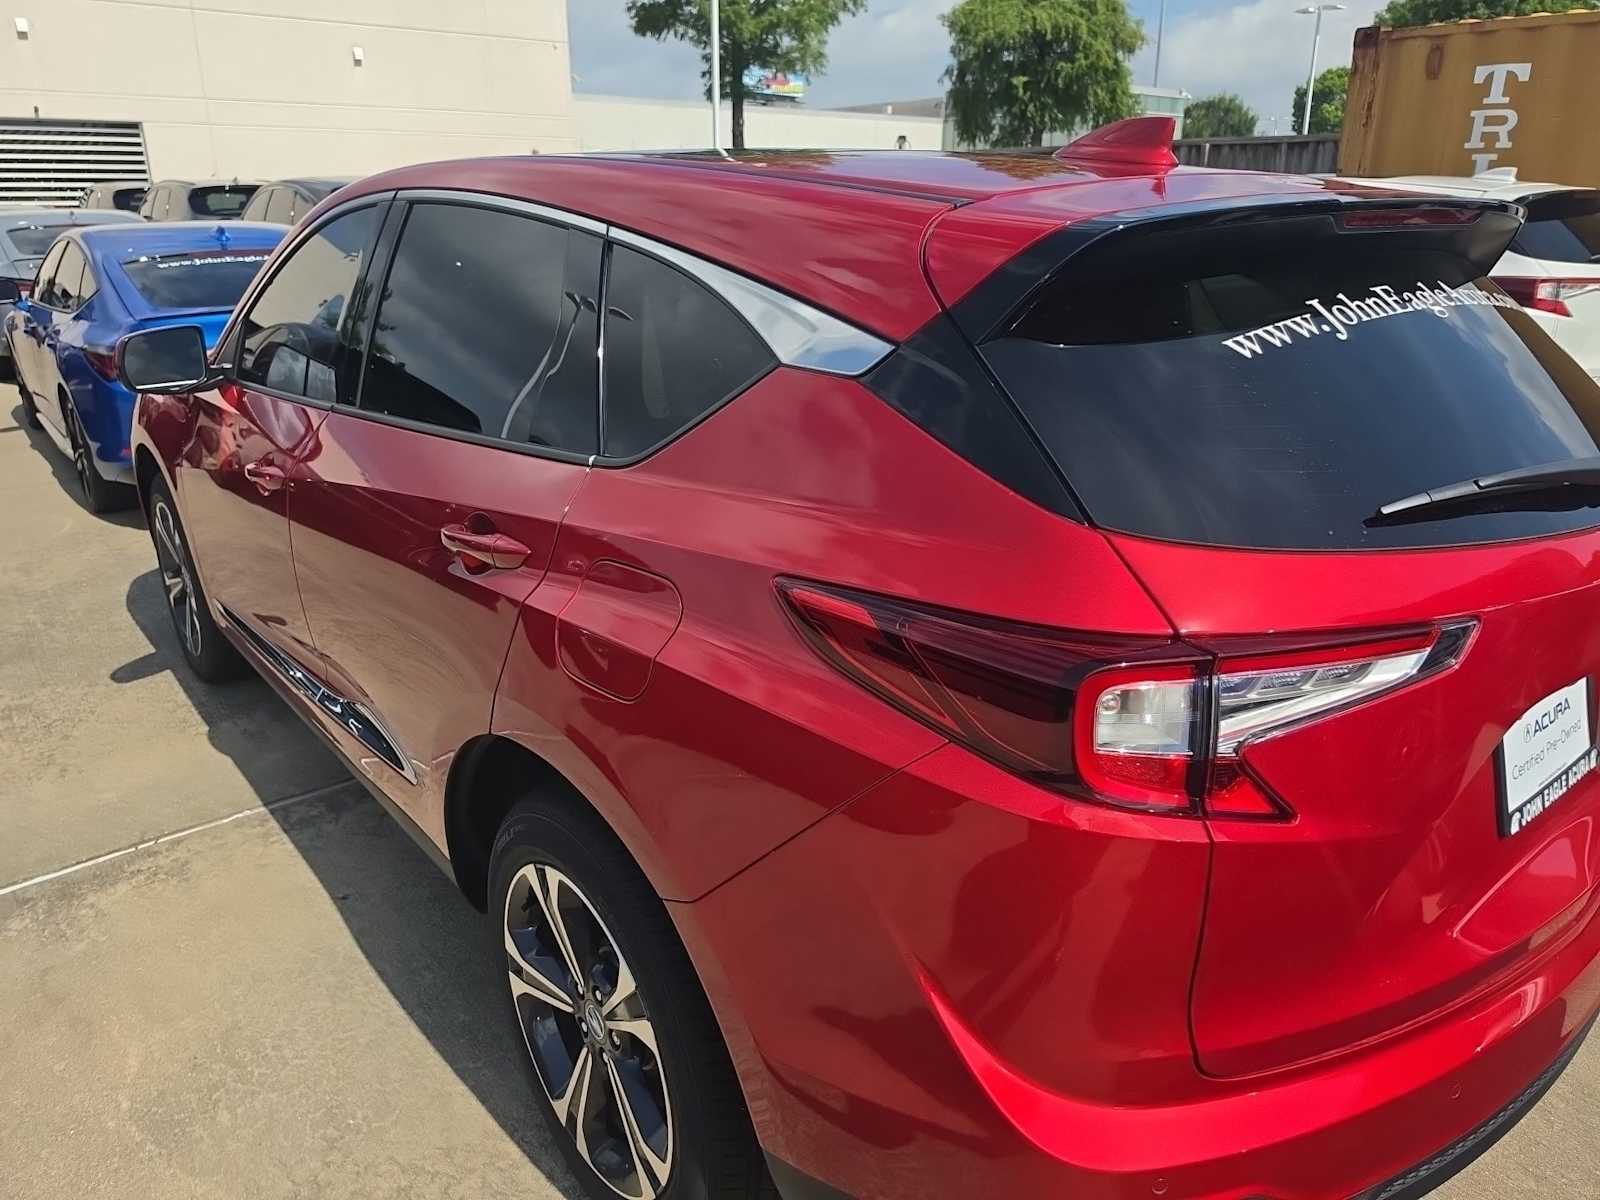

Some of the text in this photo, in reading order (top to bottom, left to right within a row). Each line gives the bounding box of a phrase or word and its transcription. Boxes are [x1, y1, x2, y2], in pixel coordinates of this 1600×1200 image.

[1533, 697, 1571, 737] ACURA
[1511, 747, 1545, 780] Certified
[1546, 719, 1582, 754] Pre-Owned
[1521, 794, 1543, 826] JOHN
[1544, 773, 1568, 808] EAGLE
[1568, 754, 1590, 789] ACURA
